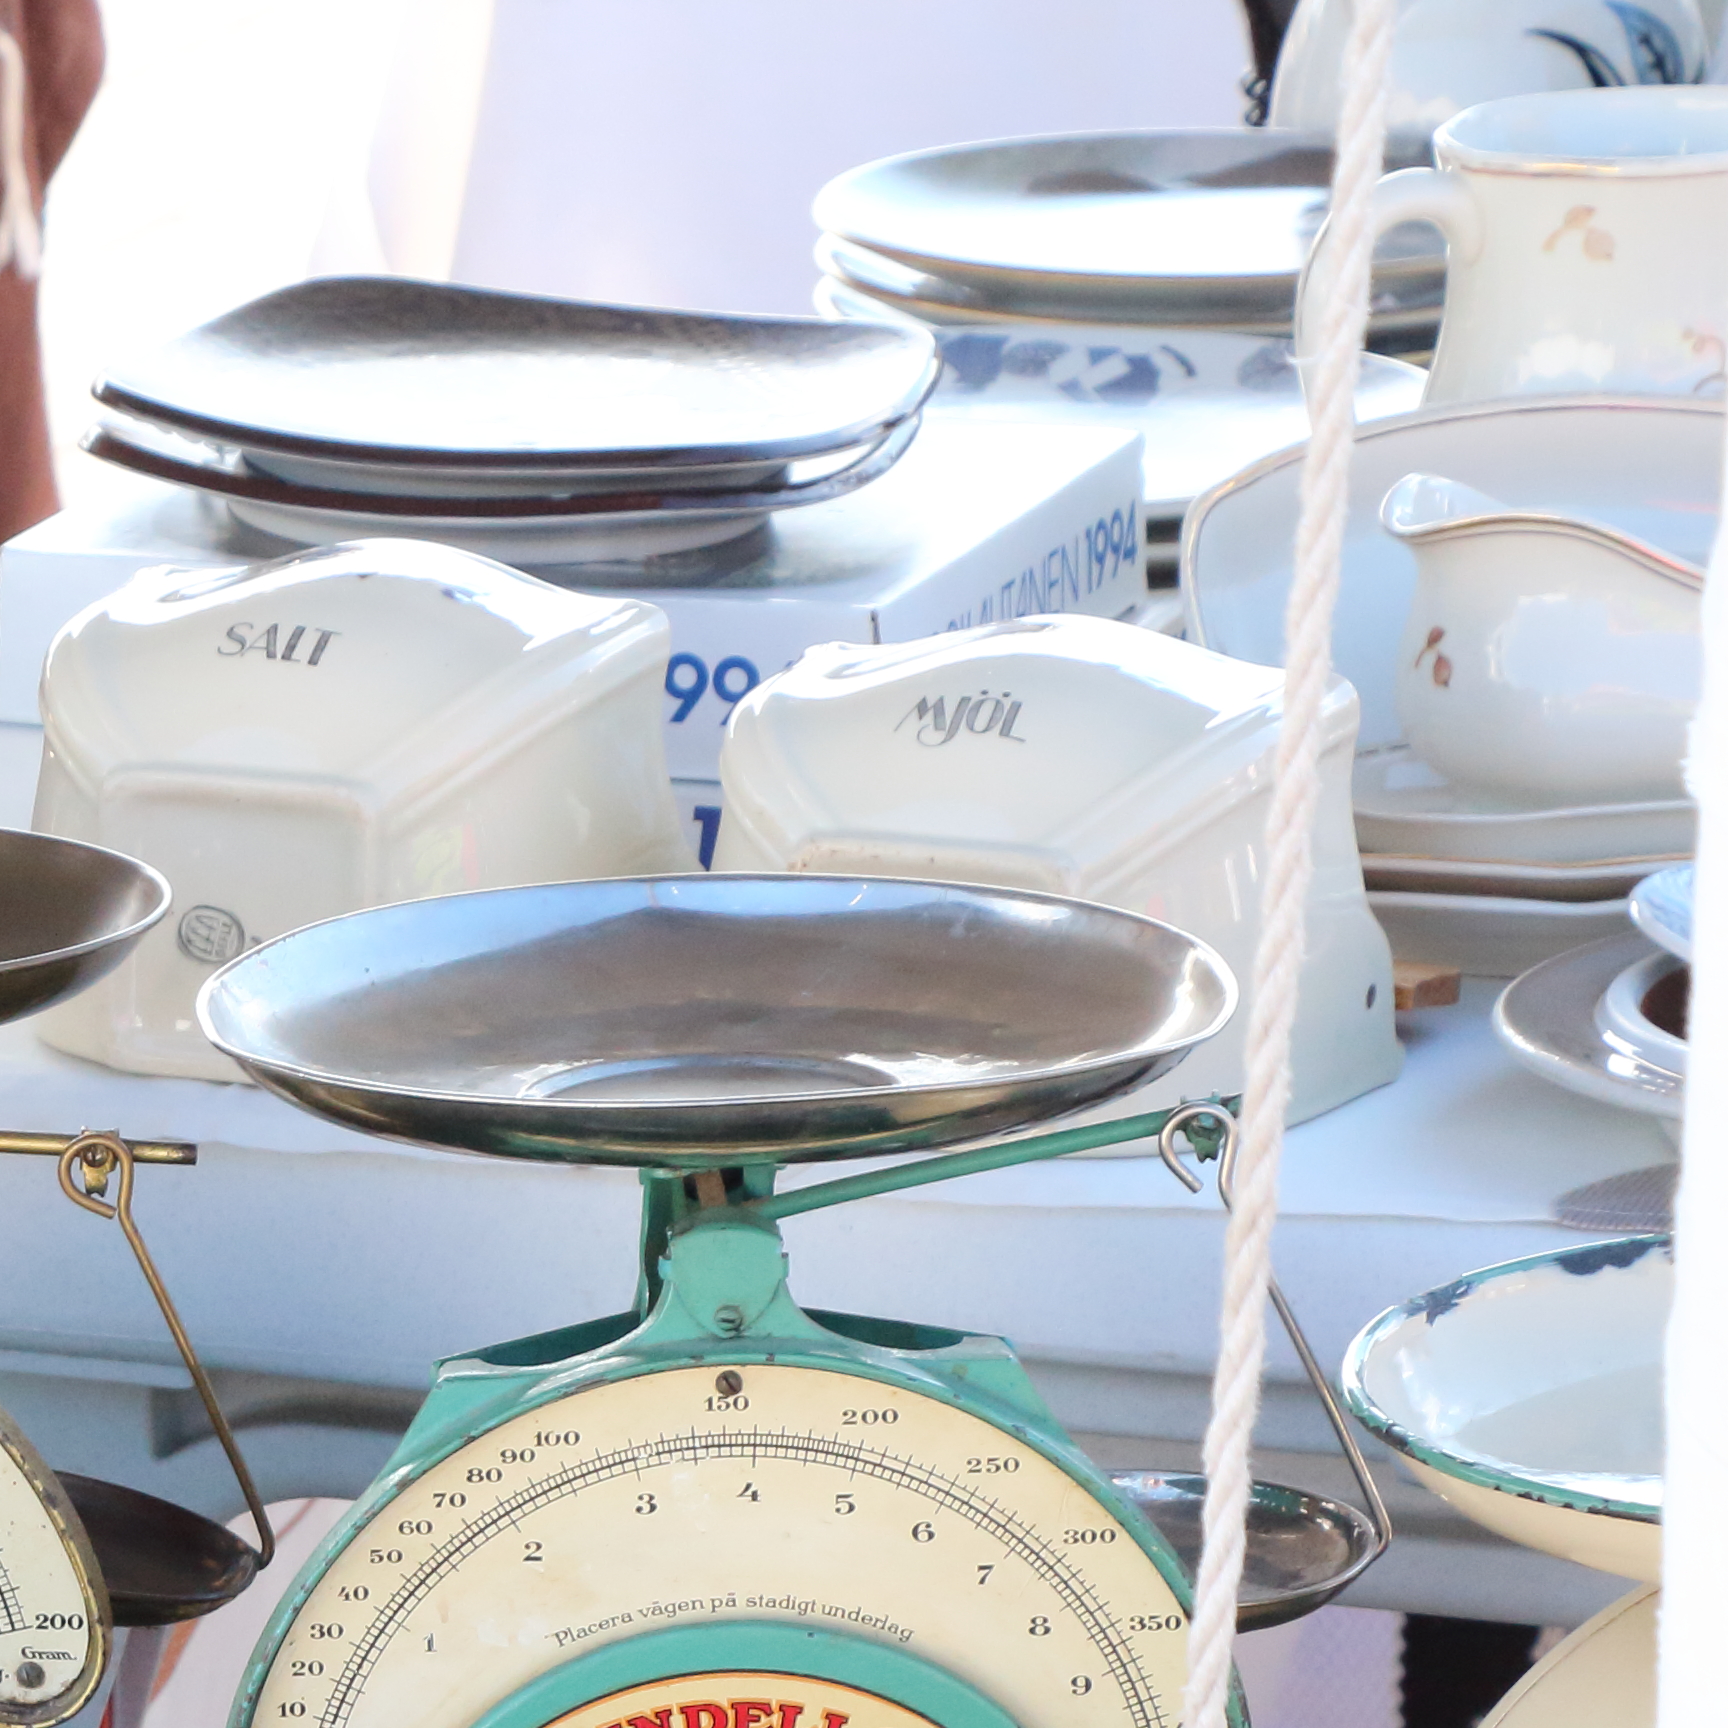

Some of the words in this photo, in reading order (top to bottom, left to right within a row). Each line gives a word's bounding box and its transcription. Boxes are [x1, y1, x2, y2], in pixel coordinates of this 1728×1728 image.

[1085, 498, 1138, 594] 1994
[217, 621, 343, 667] SALT
[894, 689, 1027, 747] MJÖL
[704, 1395, 750, 1412] 150
[841, 1407, 899, 1425] 200
[533, 1430, 581, 1447] 100
[500, 1448, 536, 1464] 90
[965, 1456, 1020, 1474] 250
[466, 1467, 503, 1484] 80
[432, 1492, 467, 1508] 70
[736, 1481, 761, 1503] 4
[635, 1493, 657, 1516] 3
[834, 1493, 856, 1515] 5
[398, 1520, 433, 1535] 60
[911, 1520, 936, 1543] 6
[1062, 1527, 1117, 1545] 300
[369, 1549, 404, 1564] 50
[522, 1541, 544, 1562] 2
[976, 1563, 996, 1586] 7
[337, 1585, 369, 1601] 40
[34, 1613, 84, 1631] 200
[553, 1611, 634, 1648] Placera
[745, 1594, 816, 1617] stadigt
[820, 1602, 915, 1643] underlag
[1028, 1615, 1052, 1636] 8
[1128, 1614, 1182, 1632] 350
[309, 1622, 344, 1639] 30
[423, 1632, 437, 1653] 1
[291, 1660, 324, 1677] 20
[1070, 1675, 1092, 1696] 9
[277, 1700, 307, 1718] 10
